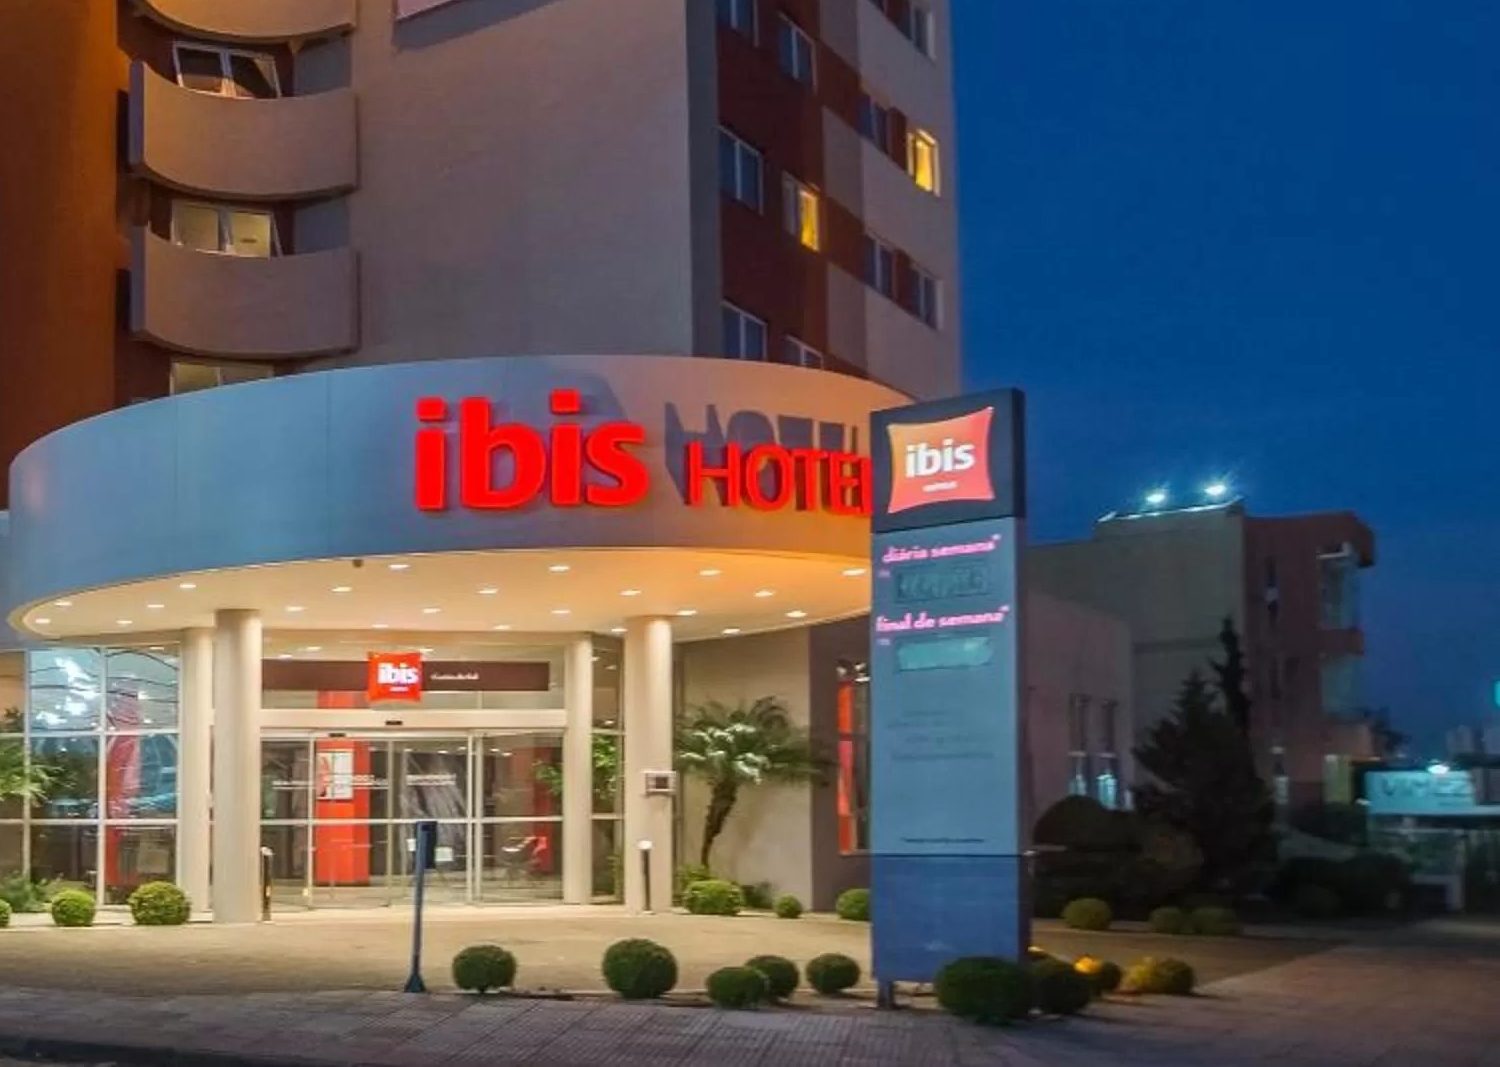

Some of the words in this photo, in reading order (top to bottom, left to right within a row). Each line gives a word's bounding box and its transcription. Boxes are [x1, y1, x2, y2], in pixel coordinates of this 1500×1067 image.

[415, 389, 651, 511] ibis
[905, 438, 977, 478] ibis
[377, 662, 420, 684] ibis
